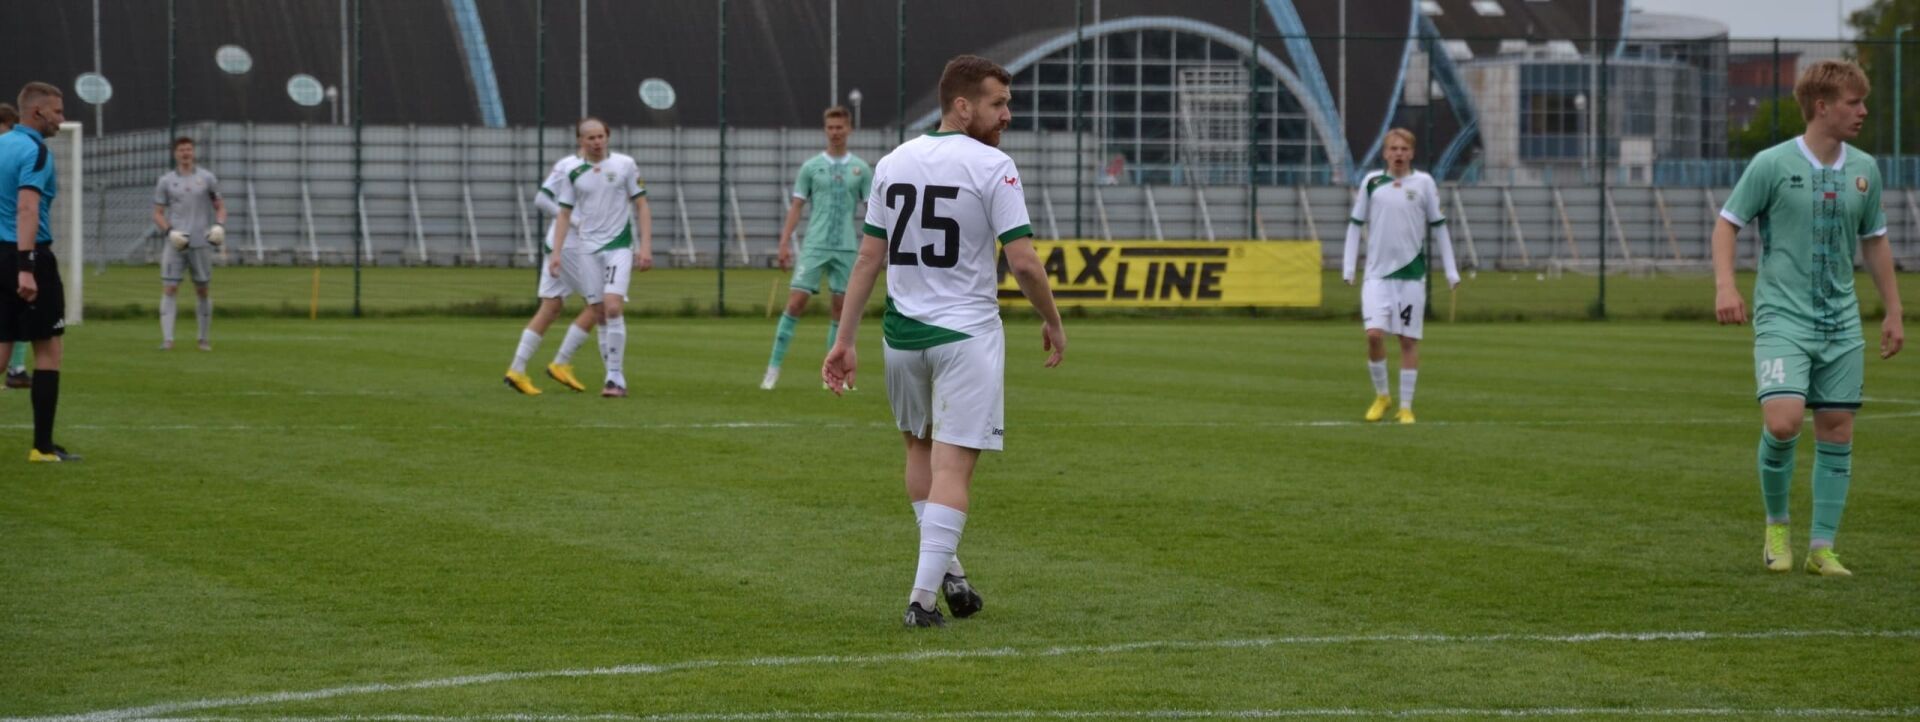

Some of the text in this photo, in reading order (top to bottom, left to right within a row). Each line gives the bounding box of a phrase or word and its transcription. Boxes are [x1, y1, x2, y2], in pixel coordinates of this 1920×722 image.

[886, 183, 960, 268] 25
[1112, 262, 1227, 300] LINE
[1760, 358, 1785, 386] 24
